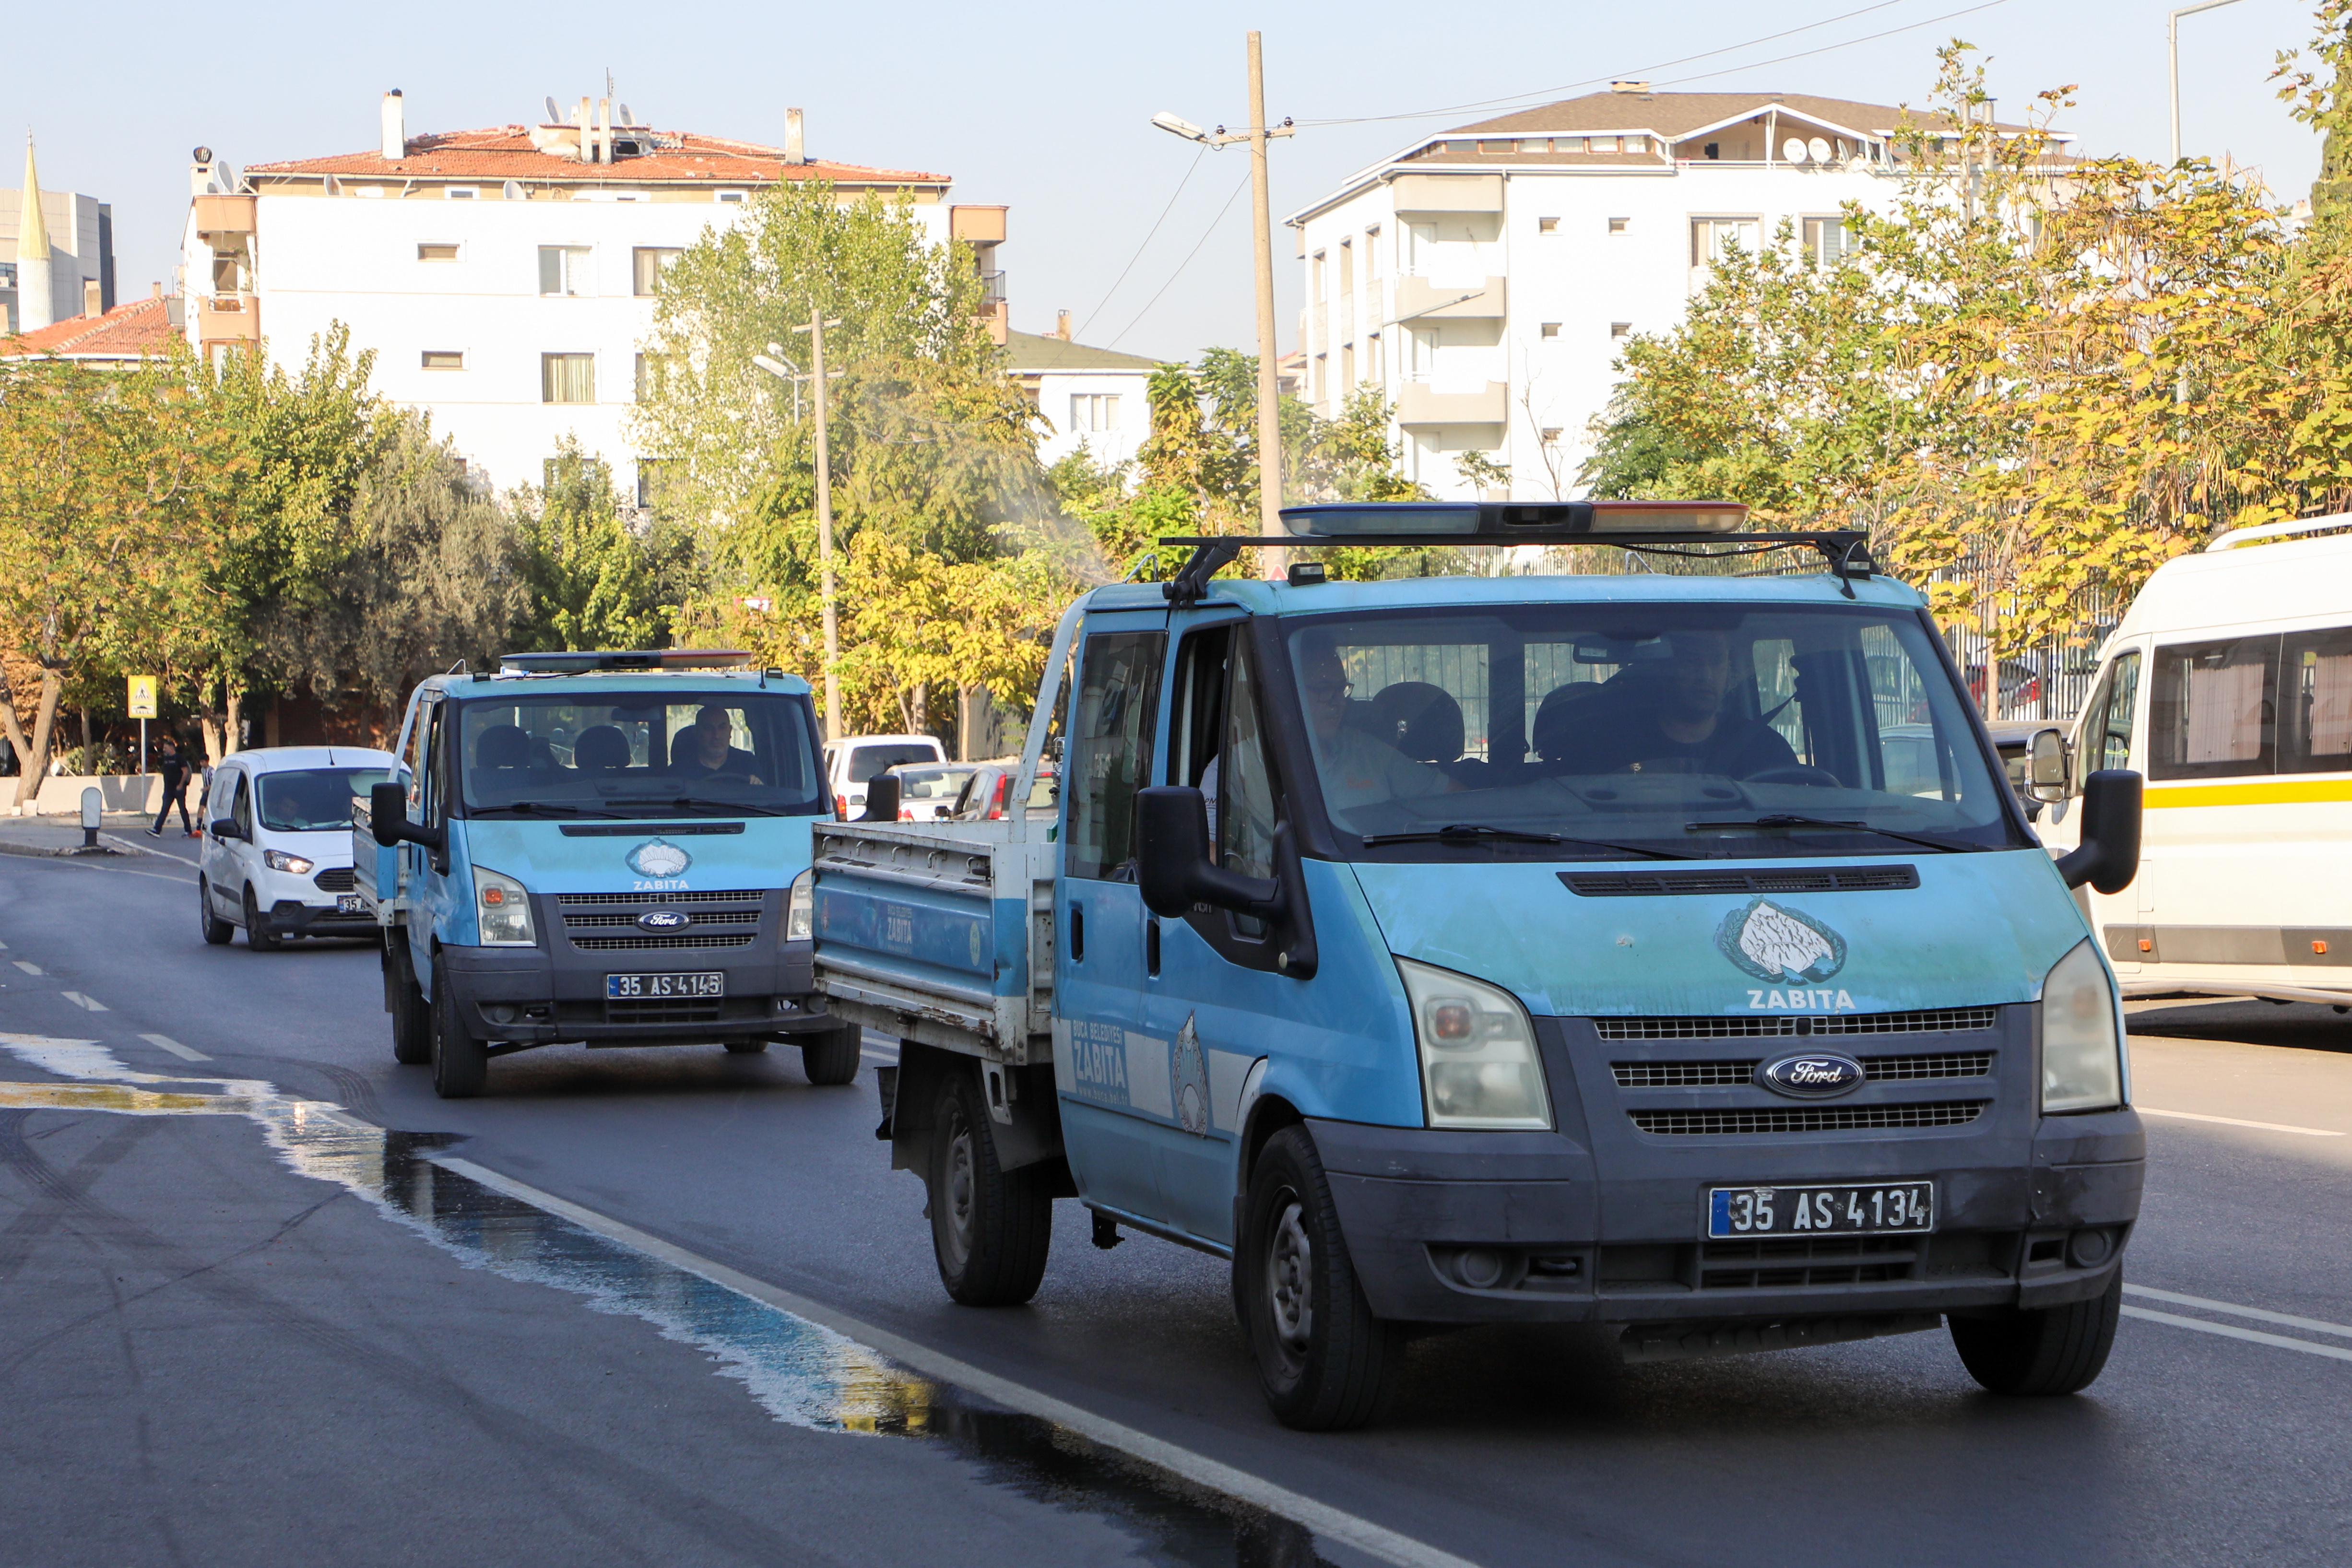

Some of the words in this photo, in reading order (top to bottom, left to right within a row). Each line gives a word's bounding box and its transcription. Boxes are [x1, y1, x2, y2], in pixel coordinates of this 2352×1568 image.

[633, 880, 689, 890] ZABITA
[345, 899, 356, 909] 35
[650, 914, 677, 925] Ford
[887, 917, 912, 944] ZABITA
[620, 977, 640, 995] 35
[650, 977, 671, 995] AS
[678, 975, 719, 994] 4145
[1747, 990, 1856, 1010] ZABITA
[1073, 1020, 1088, 1038] BUCA
[1074, 1040, 1125, 1089] ZABITA
[1791, 1061, 1842, 1084] Ford
[1735, 1194, 1773, 1231] 35
[1794, 1192, 1833, 1229] AS
[1847, 1189, 1925, 1228] 4134
